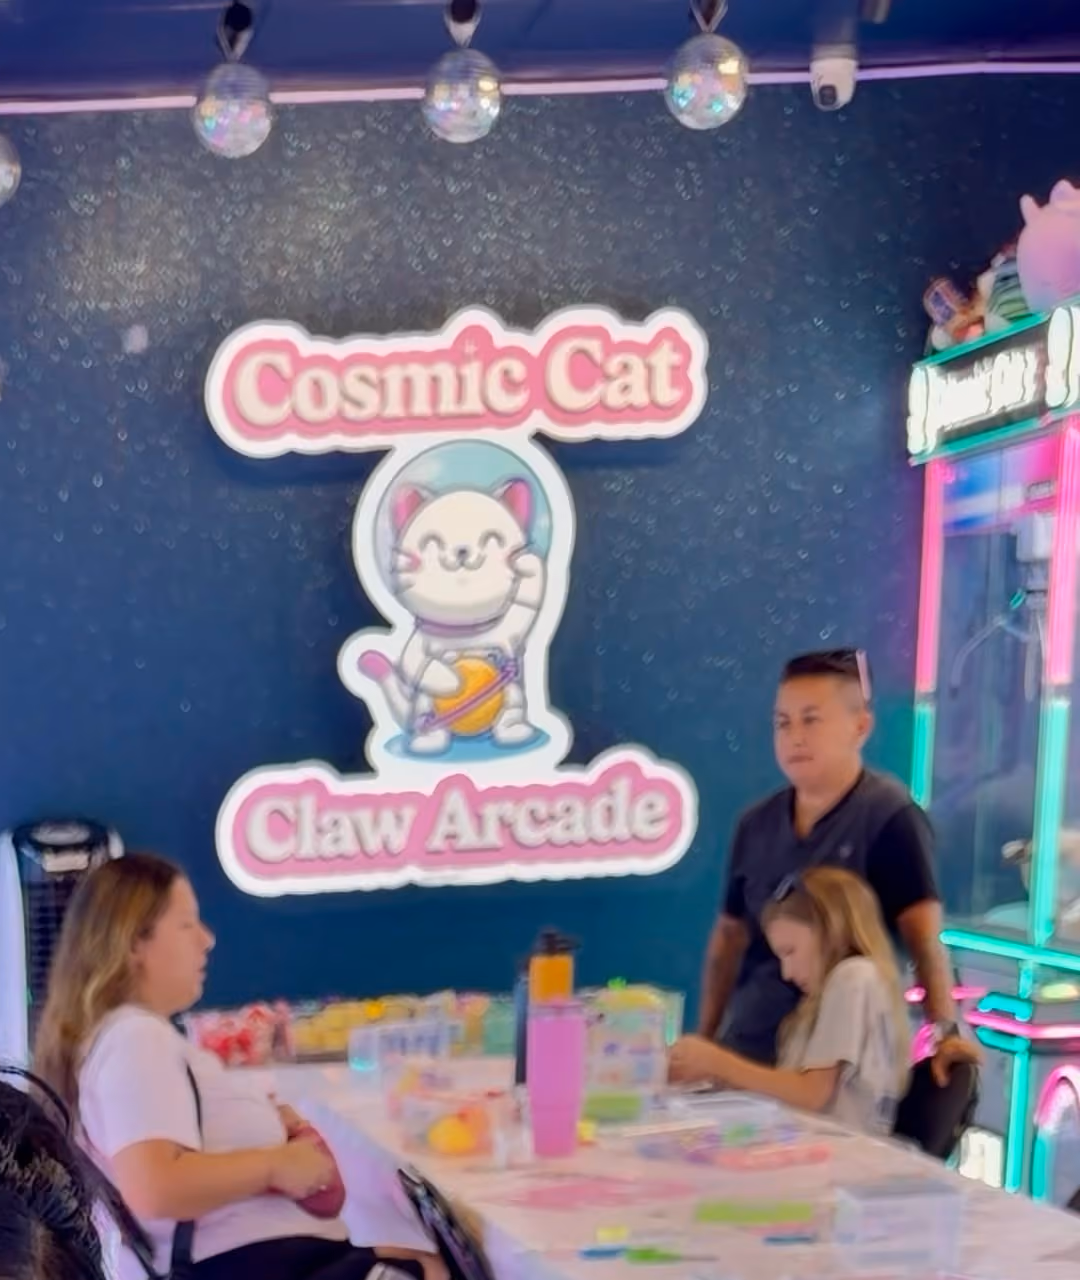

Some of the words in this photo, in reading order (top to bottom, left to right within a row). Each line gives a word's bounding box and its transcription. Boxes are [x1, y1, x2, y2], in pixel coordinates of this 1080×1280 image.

[235, 340, 530, 427] Cosmic
[545, 337, 684, 414] Cat
[245, 796, 414, 863] Claw
[427, 776, 670, 852] Arcade
